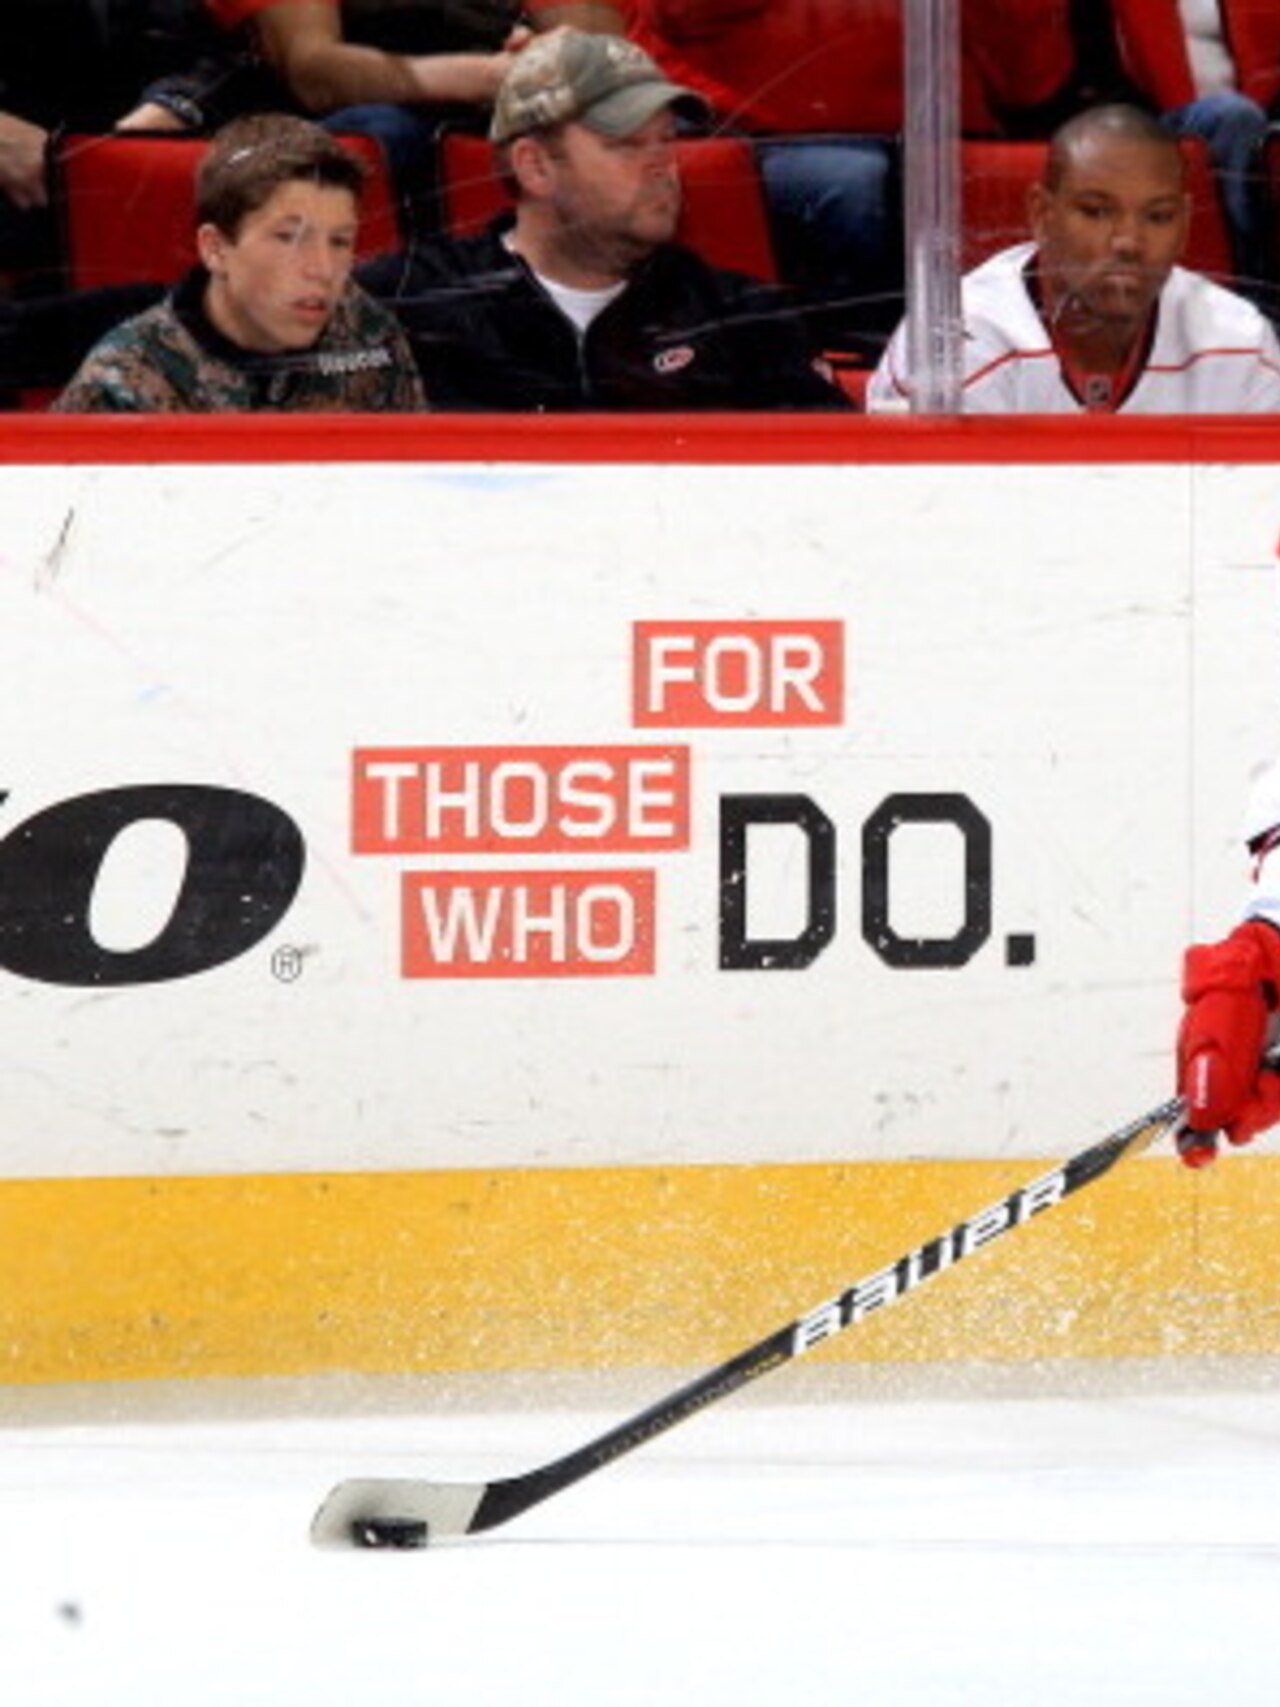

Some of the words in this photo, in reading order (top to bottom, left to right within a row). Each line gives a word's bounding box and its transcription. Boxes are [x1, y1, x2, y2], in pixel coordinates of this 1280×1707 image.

[648, 635, 825, 713] FOR
[365, 759, 675, 840] THOSE
[719, 793, 1036, 970] DO.
[420, 884, 636, 963] WHO
